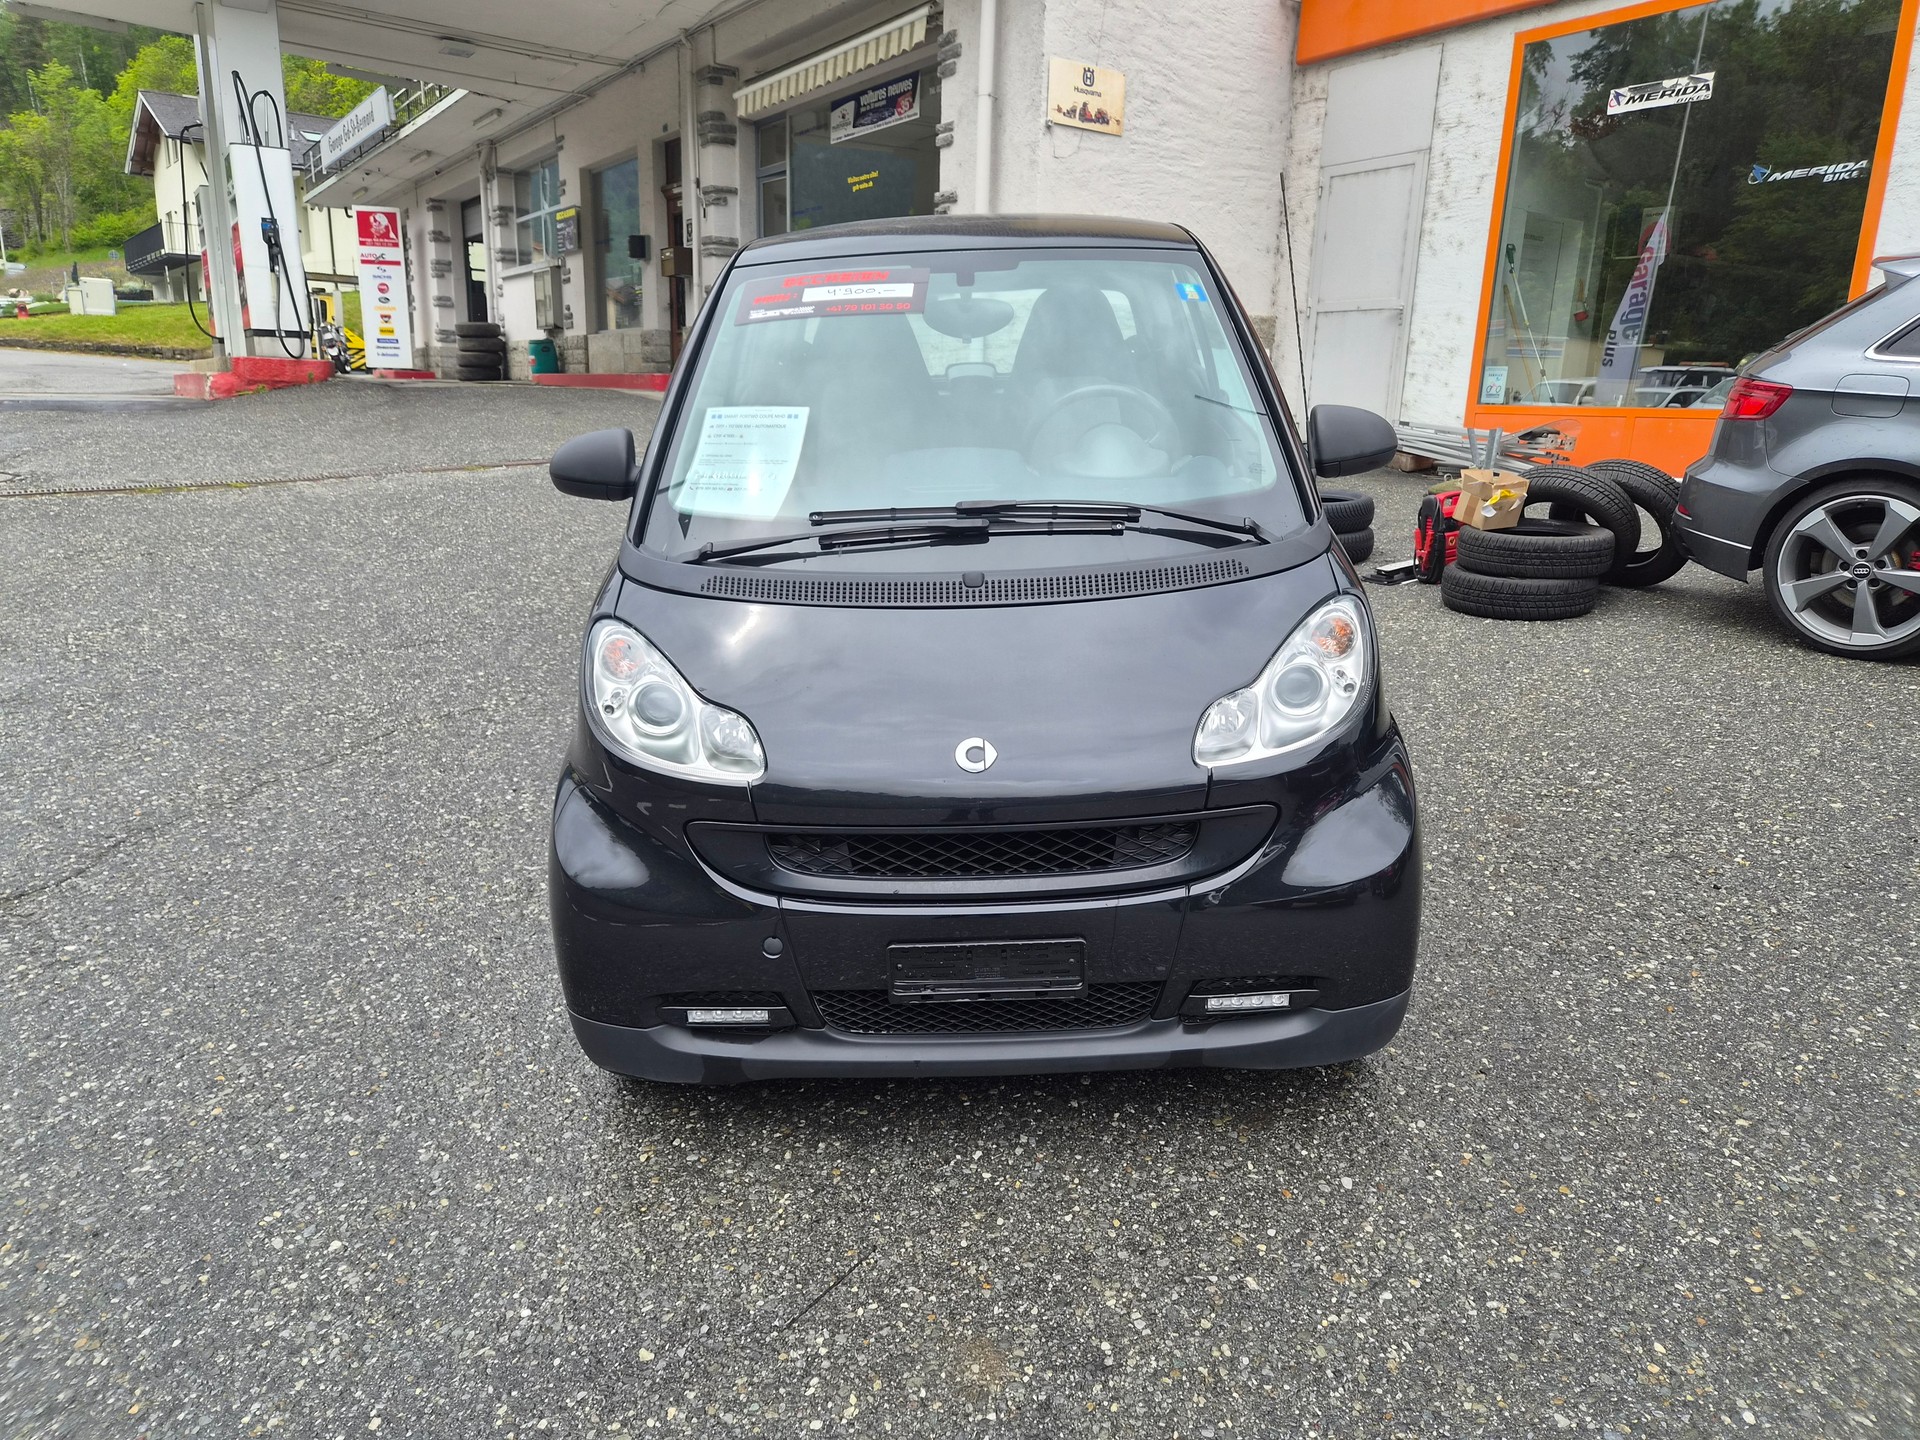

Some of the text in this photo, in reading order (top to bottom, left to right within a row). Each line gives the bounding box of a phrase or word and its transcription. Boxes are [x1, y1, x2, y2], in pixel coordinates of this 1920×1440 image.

[860, 78, 913, 106] voitures neuves
[1074, 86, 1102, 98] Husqvarna
[1624, 83, 1711, 105] MERIDA
[328, 136, 344, 154] Garage
[1767, 160, 1868, 182] MERIDA
[844, 304, 858, 312] 79
[860, 303, 876, 311] 101
[1602, 329, 1617, 368] plus
